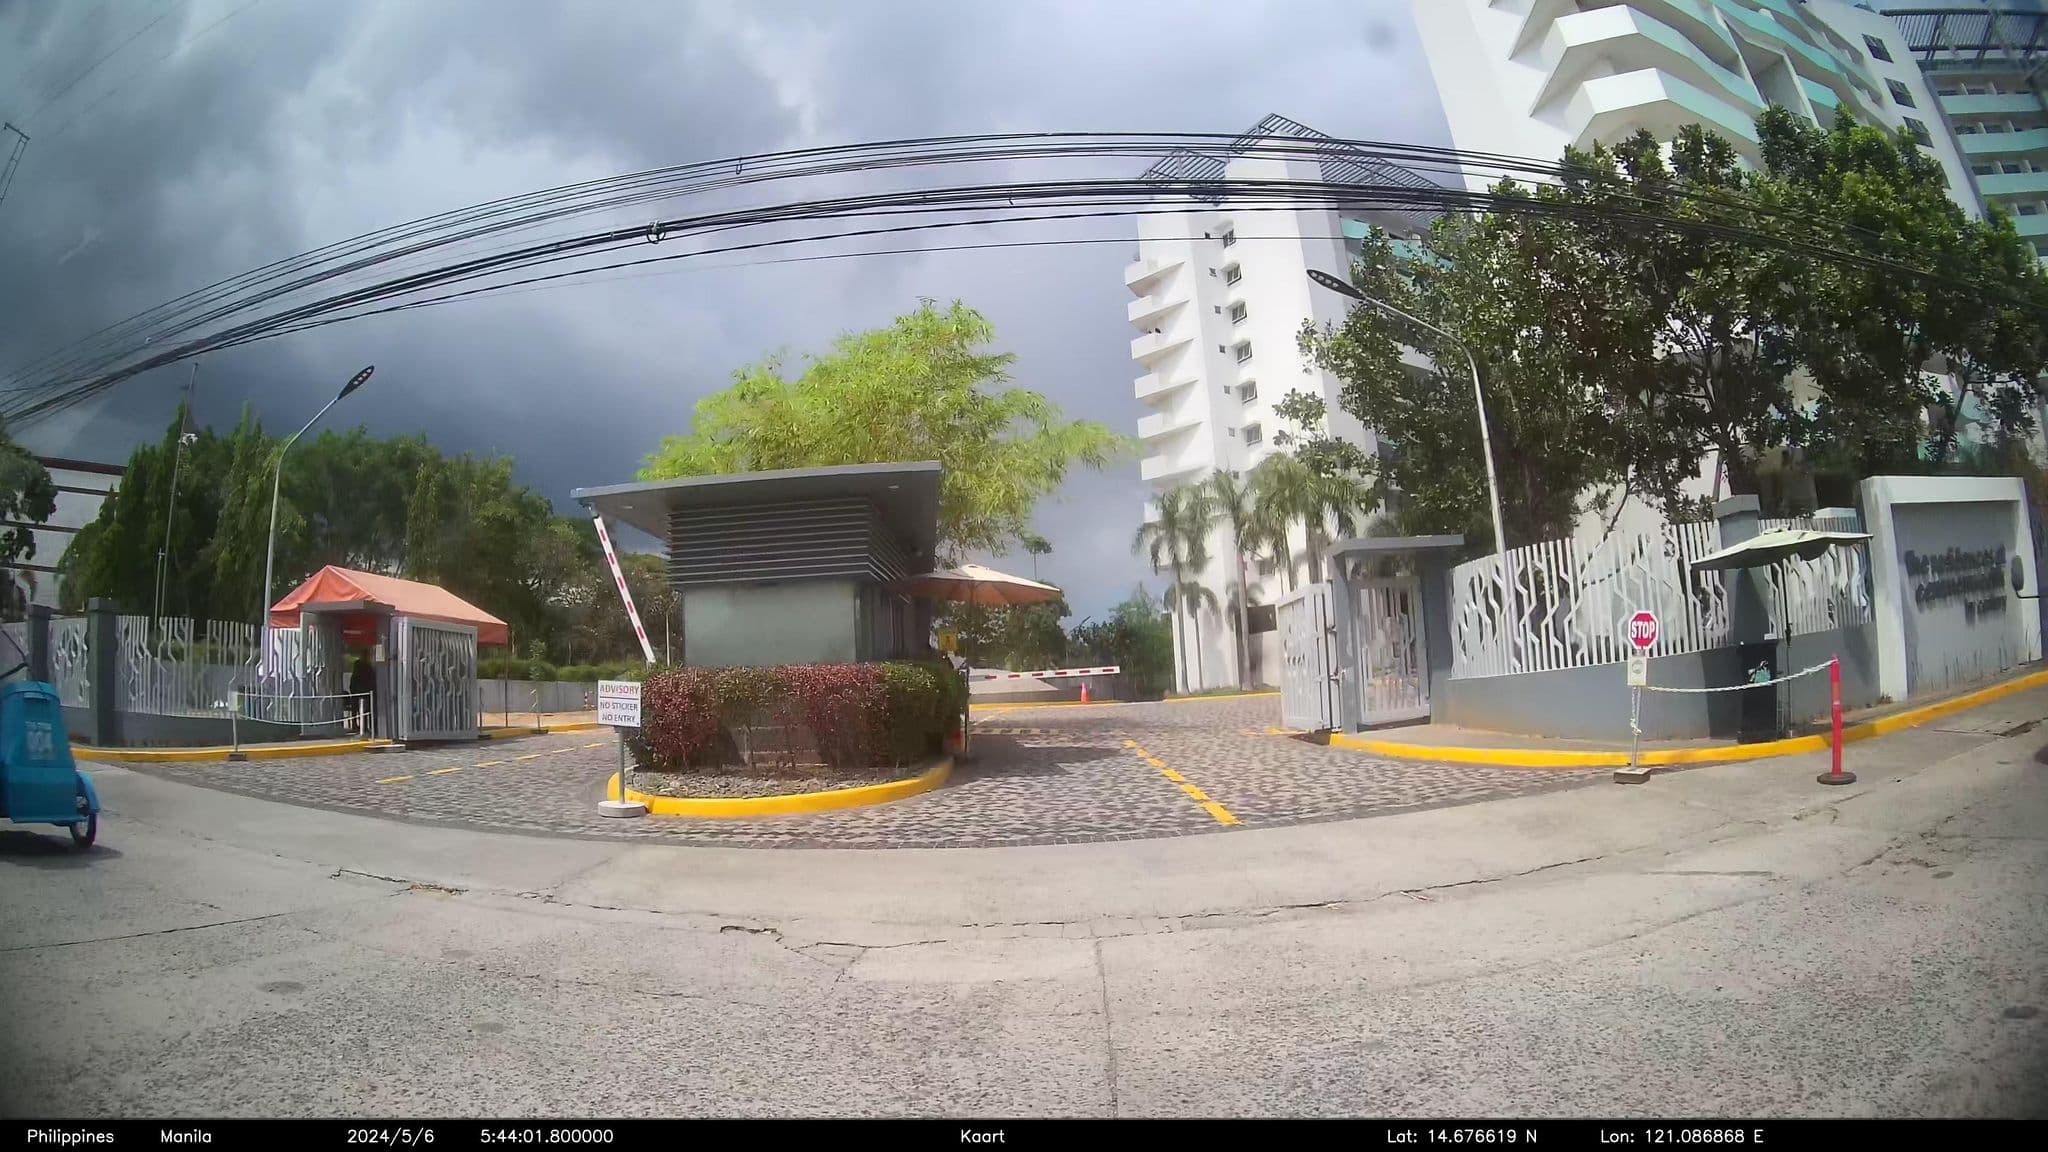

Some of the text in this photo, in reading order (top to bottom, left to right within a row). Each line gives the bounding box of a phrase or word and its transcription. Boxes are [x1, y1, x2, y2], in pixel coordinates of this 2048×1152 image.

[1631, 621, 1656, 639] STOP
[600, 684, 639, 694] ADVISORY
[612, 702, 638, 712] STICKER
[602, 713, 635, 723] NO ENTRY
